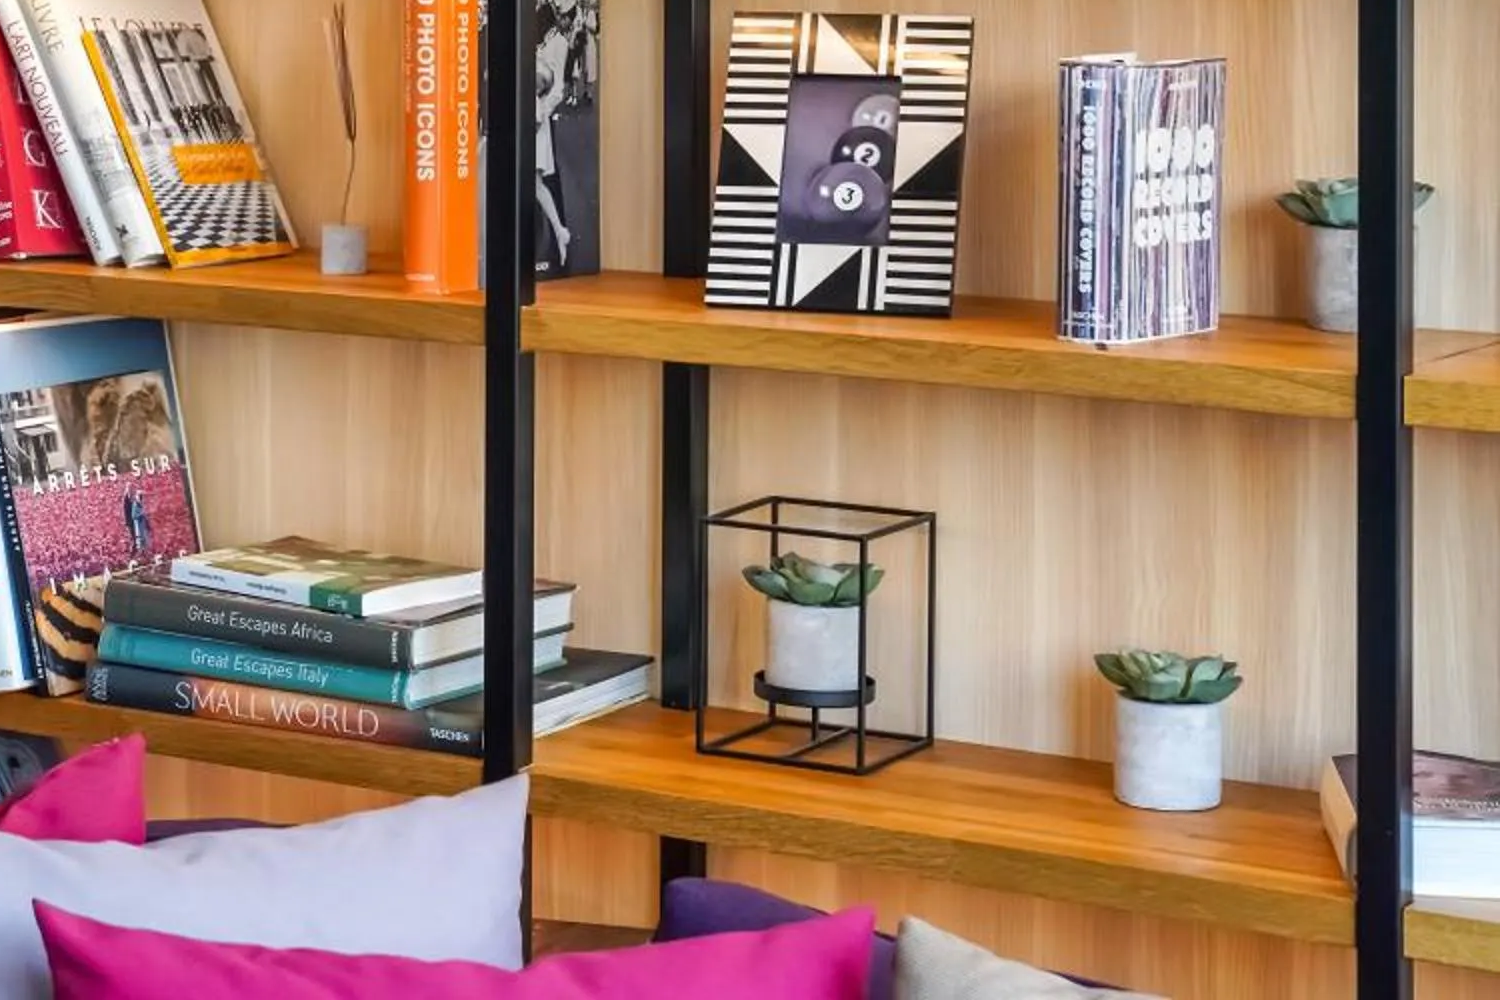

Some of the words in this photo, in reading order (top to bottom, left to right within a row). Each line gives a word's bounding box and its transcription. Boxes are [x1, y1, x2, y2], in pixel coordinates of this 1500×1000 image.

[416, 13, 436, 94] PHOTO
[457, 12, 470, 93] PHOTO
[6, 19, 35, 64] L'ART
[23, 63, 69, 157] NOUVEAU
[416, 103, 436, 181] ICONS
[457, 101, 470, 179] ICONS
[880, 114, 887, 125] 1
[1082, 105, 1096, 151] 1000
[860, 147, 874, 163] 2
[1135, 124, 1215, 173] 1000
[32, 189, 62, 229] K
[841, 187, 855, 204] 3
[1080, 154, 1095, 224] RECORD
[1133, 209, 1212, 248] COVERS
[1078, 226, 1094, 293] COVERS
[33, 464, 119, 495] ARRÊTS
[131, 454, 172, 477] SUR
[187, 604, 227, 625] Great
[229, 611, 287, 637] Escapes
[291, 621, 334, 644] Africa
[191, 646, 229, 668] Great
[234, 654, 293, 680] Escapes
[297, 663, 330, 688] Italy
[174, 681, 265, 722] SMALL
[269, 696, 379, 738] WORLD
[430, 728, 470, 742] TASCHEN
